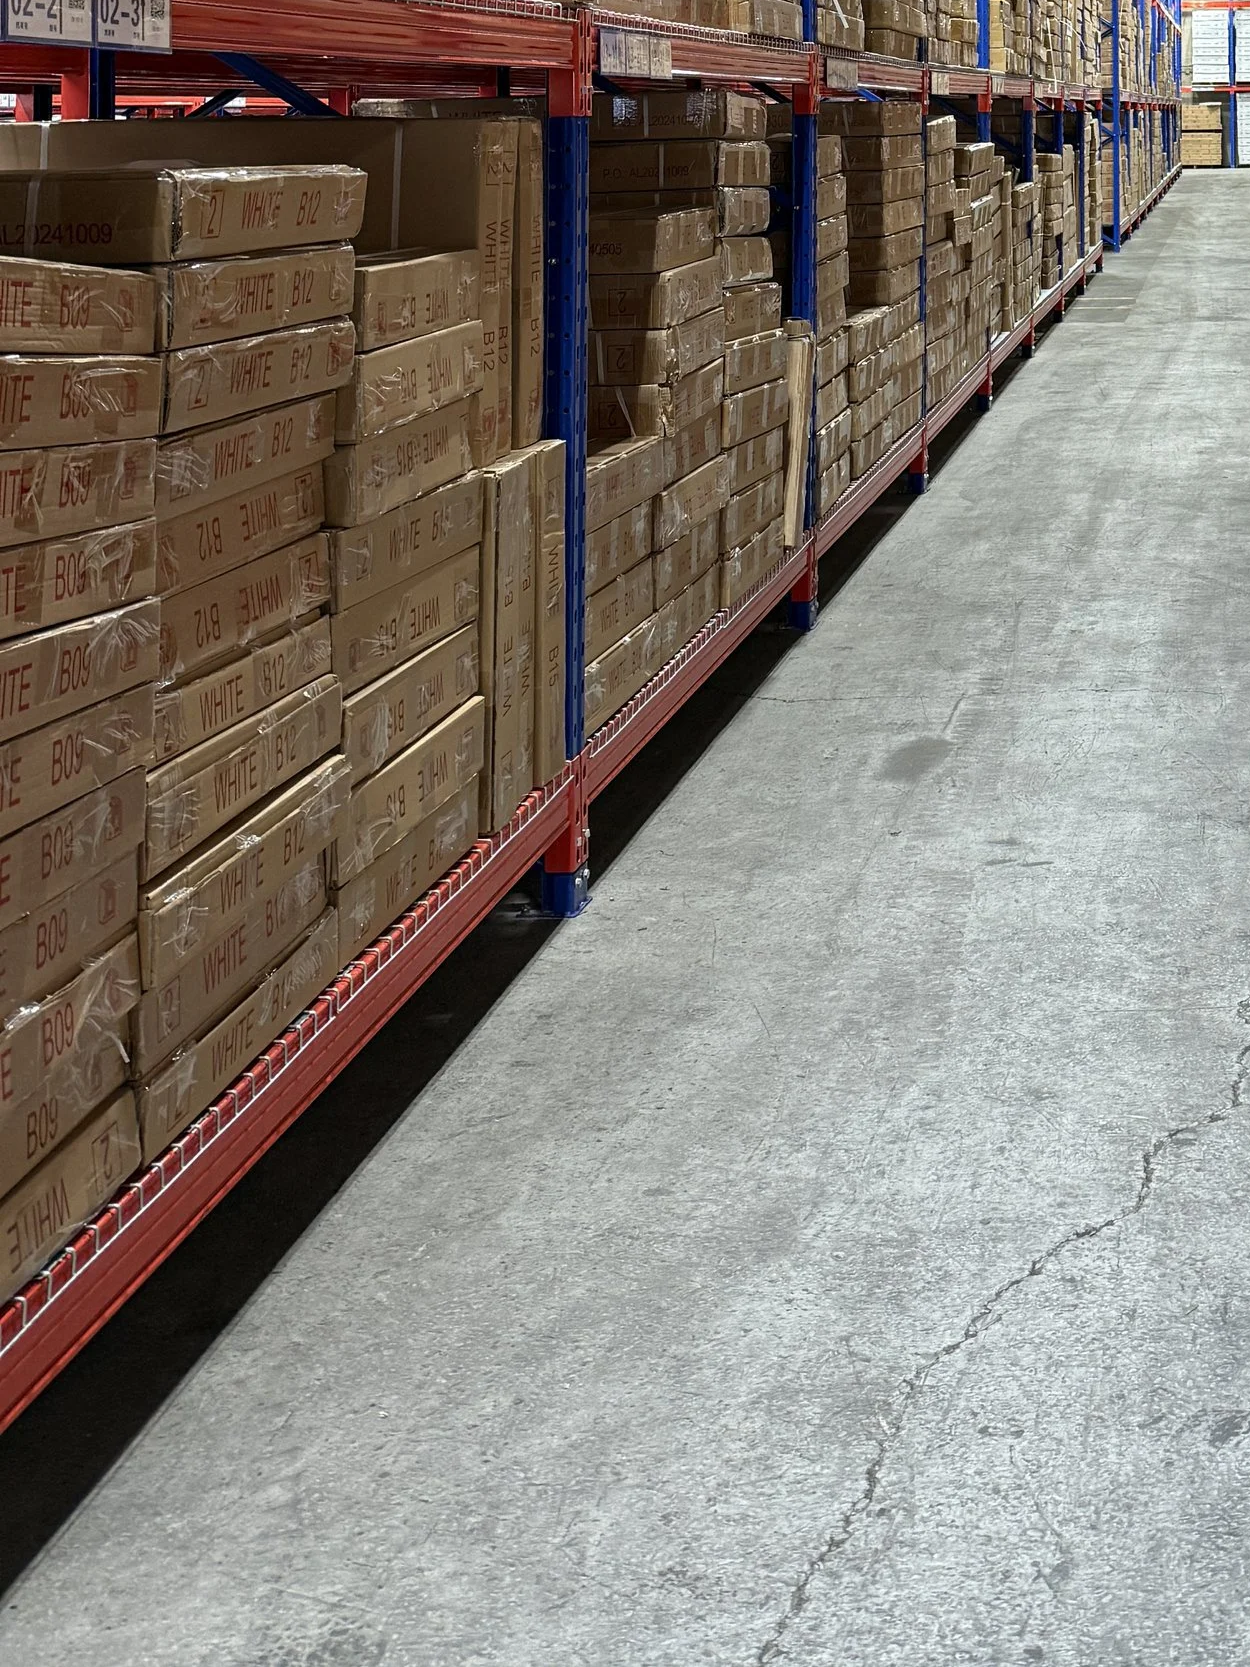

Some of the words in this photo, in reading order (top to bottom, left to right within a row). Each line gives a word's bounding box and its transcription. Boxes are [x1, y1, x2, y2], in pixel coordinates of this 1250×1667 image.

[0, 222, 113, 246] L2241009
[206, 195, 217, 233] 2
[240, 190, 284, 231] WHITE
[296, 189, 321, 226] B12
[485, 220, 498, 294] WHITE
[59, 280, 90, 329] B09
[233, 274, 274, 314] WHITE
[291, 271, 313, 307] B12
[229, 358, 273, 395] WHITE
[213, 436, 255, 480] WHITE
[270, 418, 294, 456] B12
[239, 491, 281, 535] WHITE
[198, 520, 222, 561] B12
[54, 552, 88, 602] B09
[238, 579, 284, 627] WHITE
[194, 607, 221, 650] B12
[59, 646, 91, 699] B09
[199, 672, 244, 733] WHITE
[261, 652, 288, 696] B12
[50, 738, 85, 788] B09
[213, 759, 257, 815] WHITE
[41, 832, 74, 881] B09
[219, 845, 265, 915] WHITE
[35, 921, 68, 970] B09
[201, 929, 248, 994] WHITE
[42, 1013, 76, 1066] B09
[211, 1019, 255, 1085] WHITE
[26, 1112, 60, 1160] B09
[8, 1185, 72, 1275] WHITE
